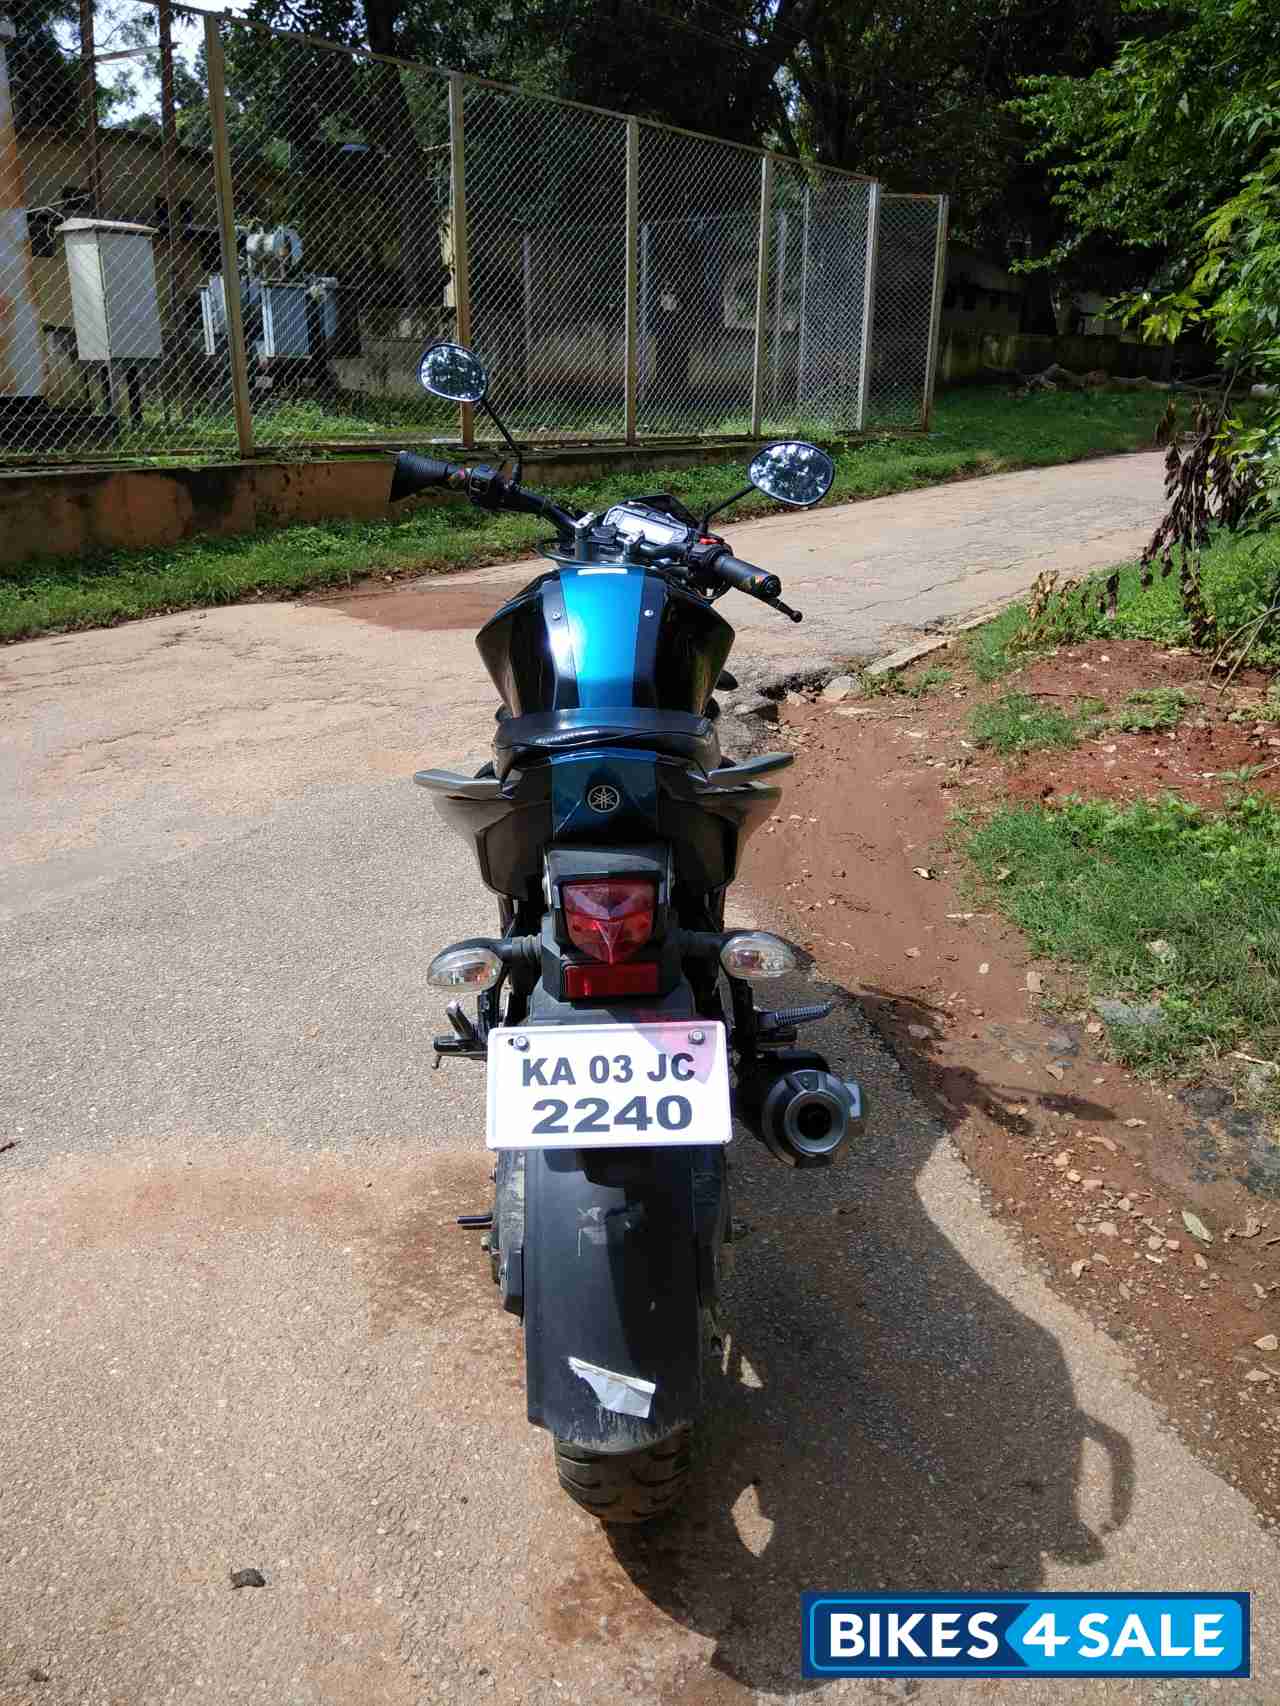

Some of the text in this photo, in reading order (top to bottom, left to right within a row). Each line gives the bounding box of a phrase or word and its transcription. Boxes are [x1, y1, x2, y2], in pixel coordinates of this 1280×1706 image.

[522, 1053, 695, 1087] KA 03 JC
[531, 1095, 693, 1134] 2240
